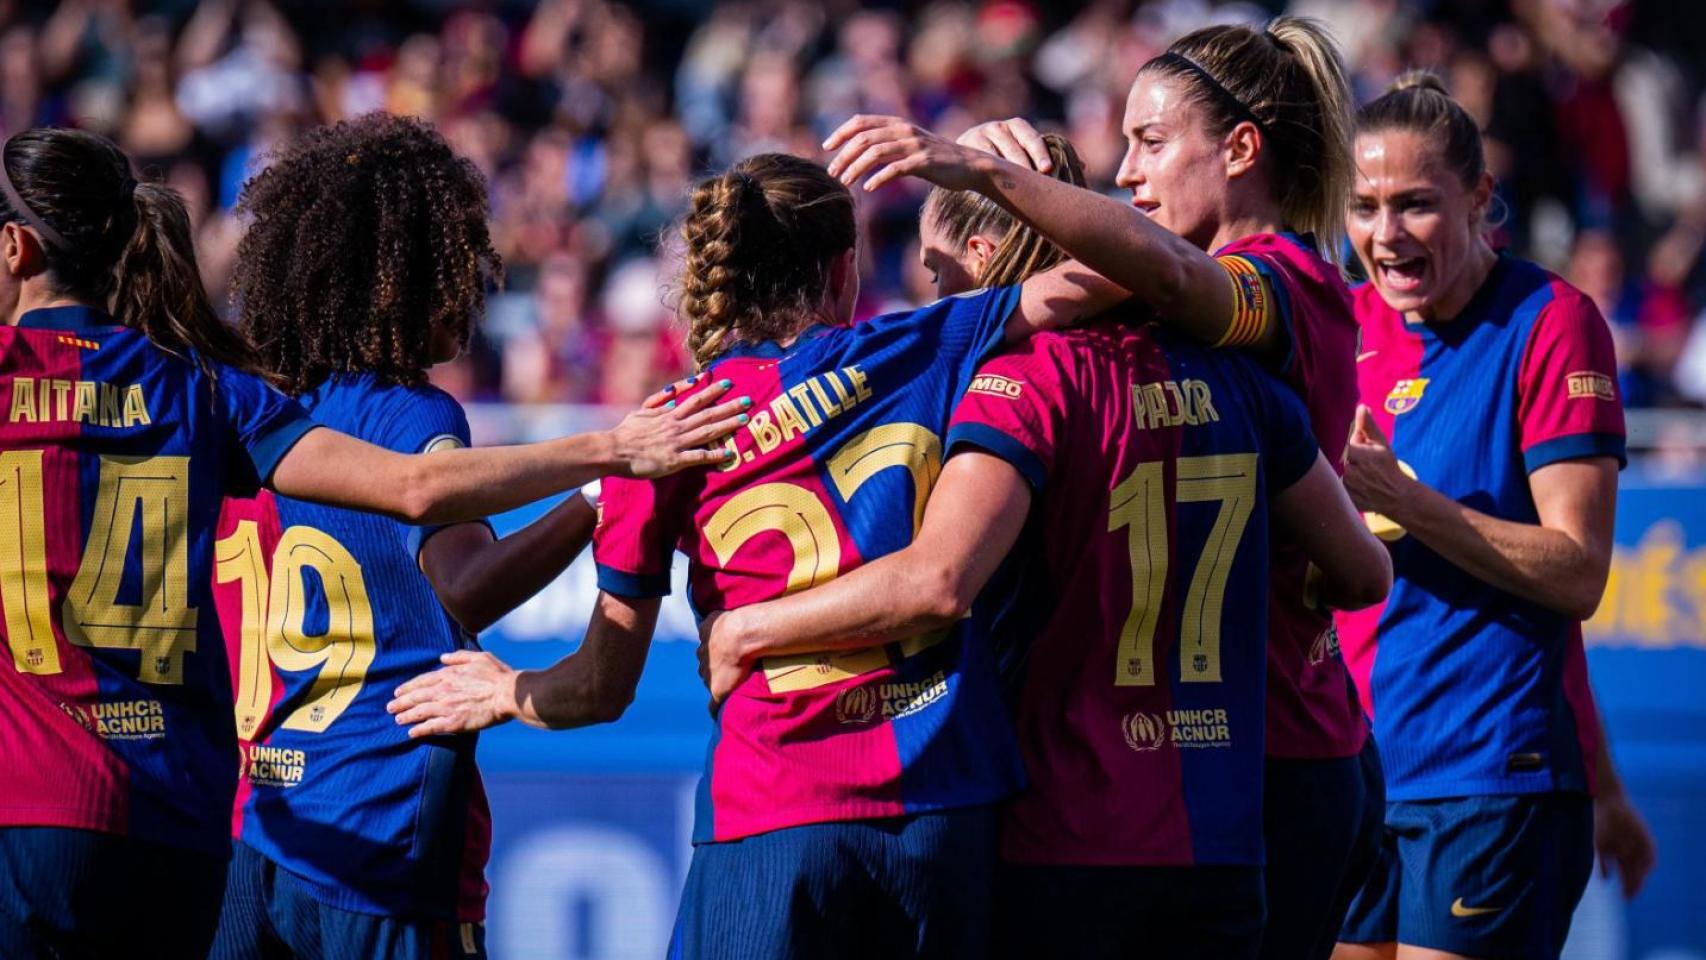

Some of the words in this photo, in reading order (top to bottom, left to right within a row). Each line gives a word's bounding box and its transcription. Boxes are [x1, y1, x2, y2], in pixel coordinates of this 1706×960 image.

[9, 377, 152, 428] AITANA
[0, 449, 199, 685] 14
[1107, 453, 1259, 687] 17
[214, 519, 376, 741] 19
[880, 670, 945, 700] UNHCR
[91, 700, 163, 719] UNHCR
[881, 680, 948, 716] ACNUR
[97, 716, 164, 734] ACNUR
[1166, 708, 1228, 726] UNHCR
[1171, 725, 1230, 741] ACNUR
[249, 745, 305, 766] UNHCR
[248, 762, 304, 782] ACNUR
